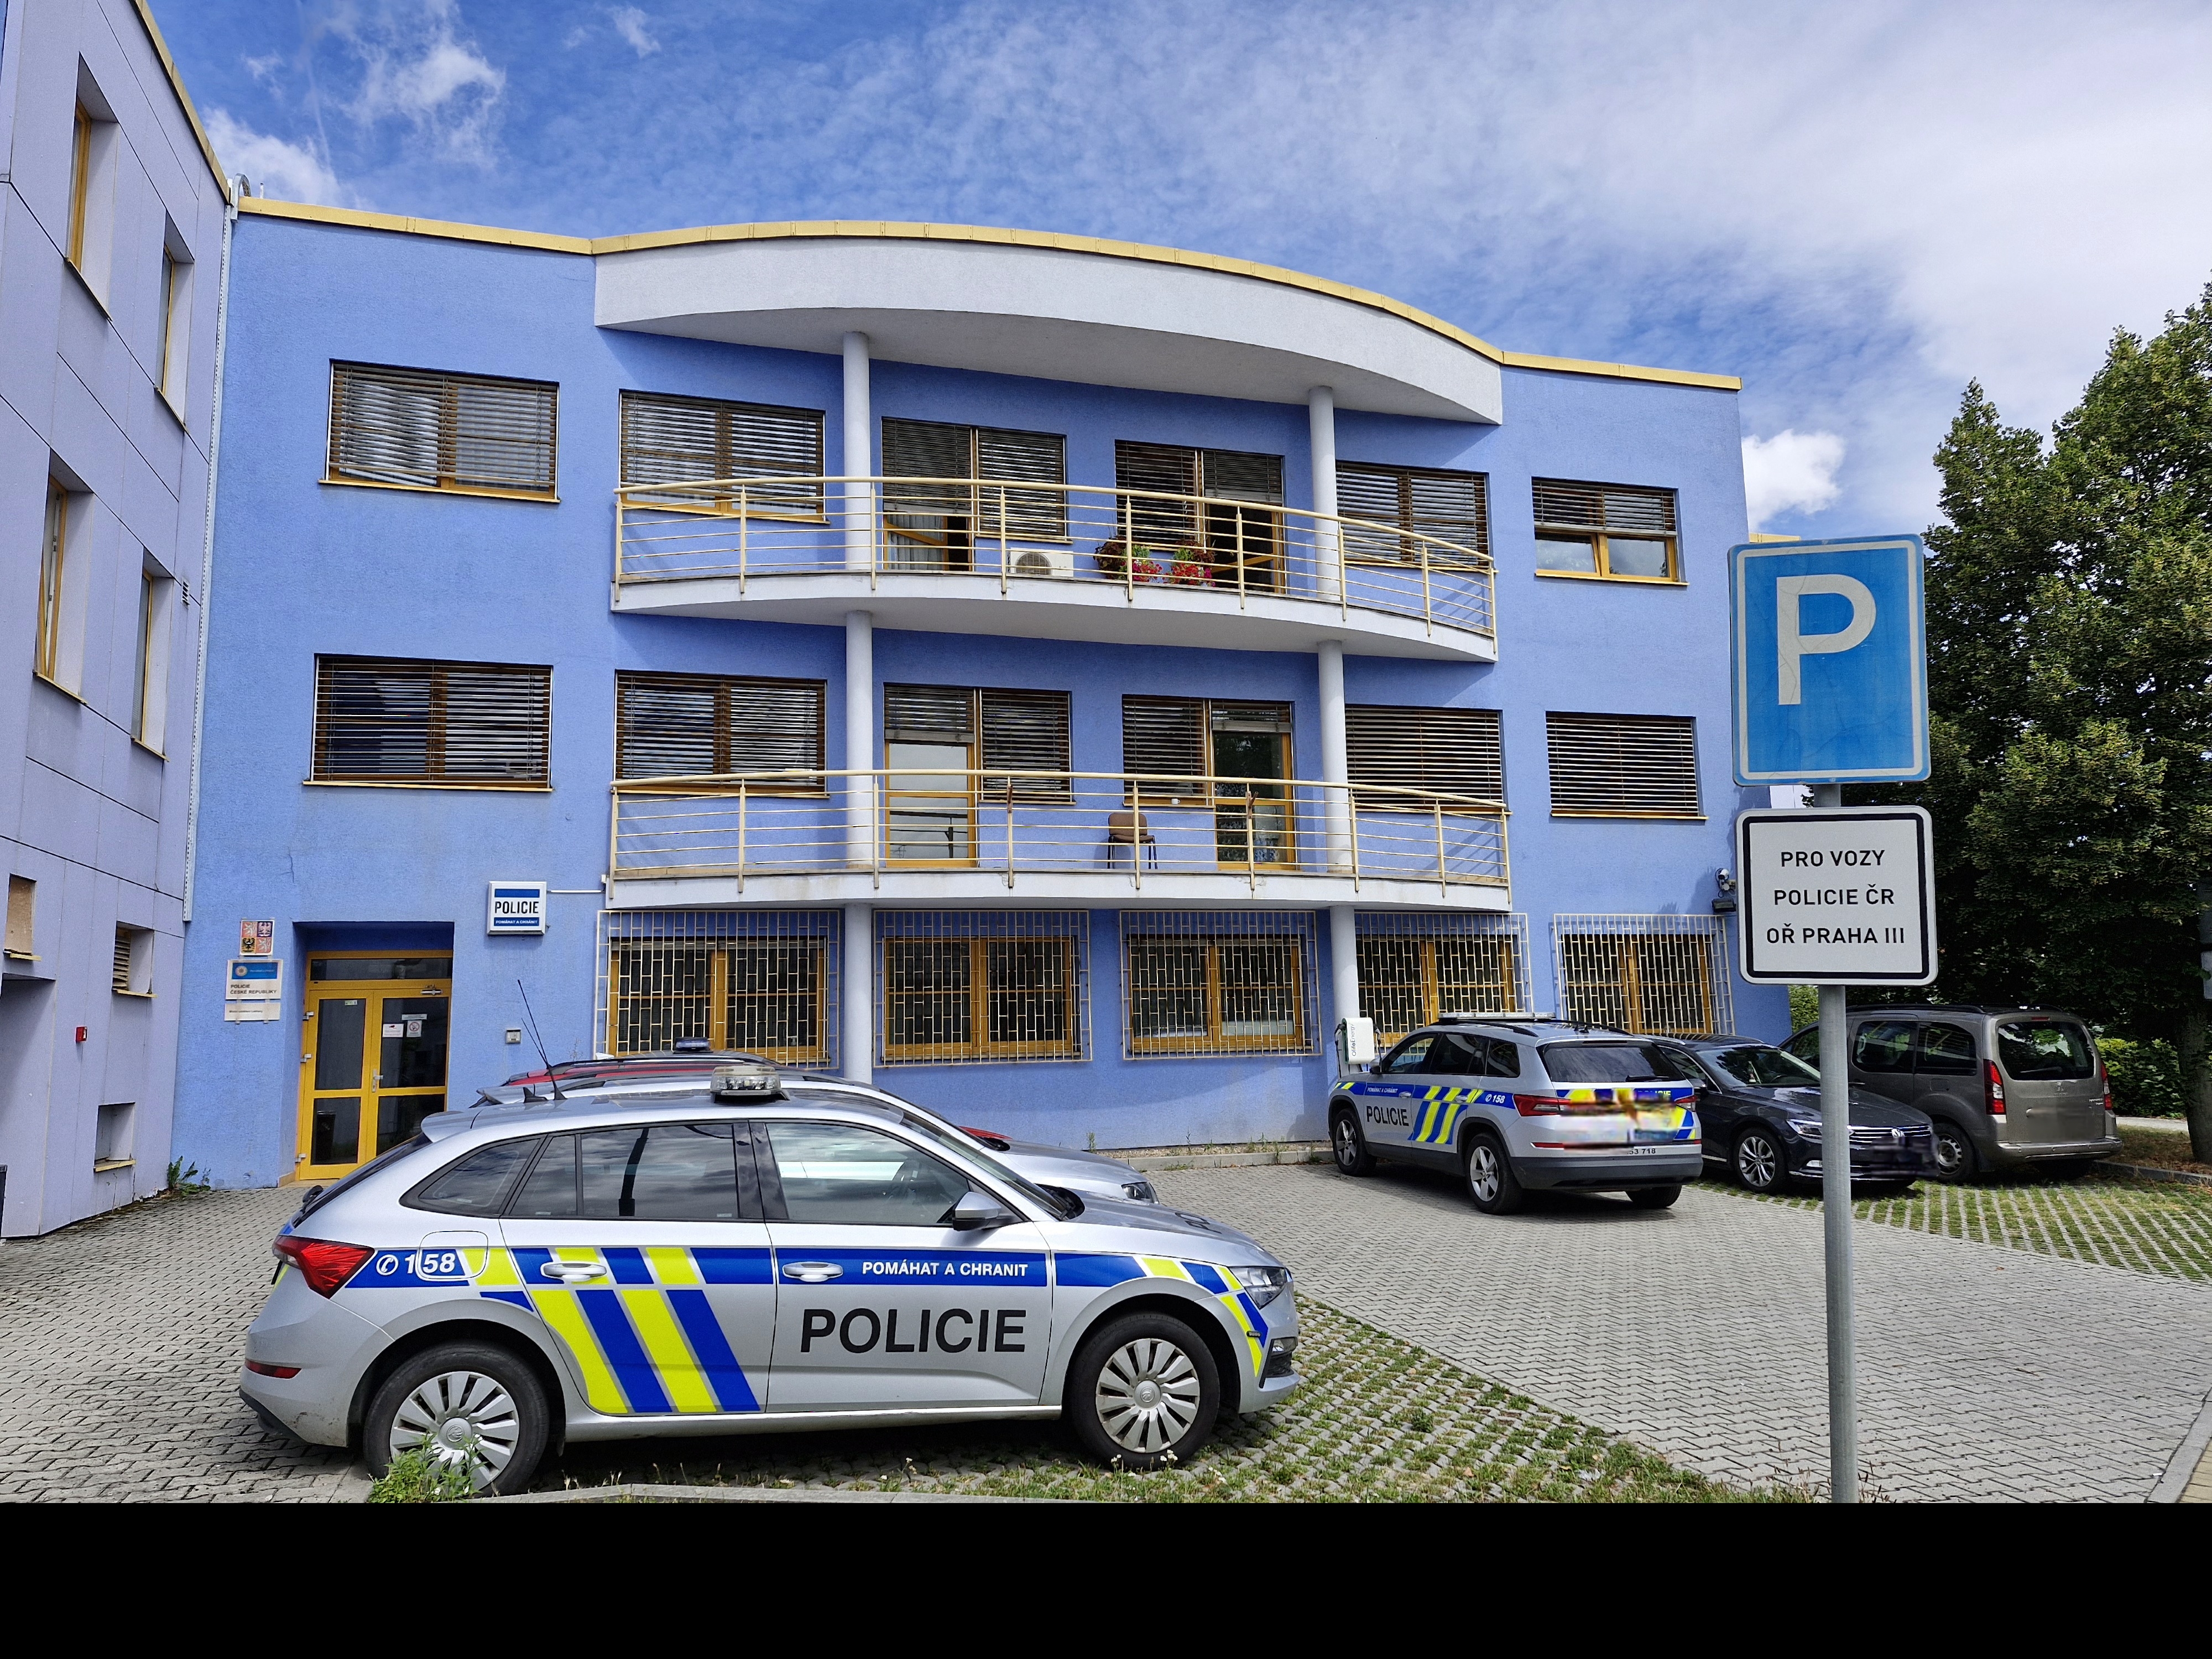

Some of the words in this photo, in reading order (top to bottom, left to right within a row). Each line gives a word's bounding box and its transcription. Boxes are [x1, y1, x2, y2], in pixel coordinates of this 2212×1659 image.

[1776, 573, 1876, 705] P
[1781, 851, 1823, 867] PRO
[1830, 850, 1885, 867] VOZY
[1774, 889, 1859, 905] POLICIE
[1866, 884, 1894, 905] ČR
[494, 901, 539, 914] POLICIE
[1767, 923, 1795, 943] OŘ
[1803, 927, 1878, 943] PRAHA
[1885, 927, 1904, 943] III
[1492, 1094, 1506, 1104] 158
[1366, 1105, 1409, 1126] POLICIE
[405, 1253, 456, 1274] 158
[863, 1259, 940, 1275] POMÁHAT
[944, 1262, 956, 1275] A
[960, 1262, 1028, 1277] CHRANIT
[800, 1308, 1026, 1353] POLICIE
